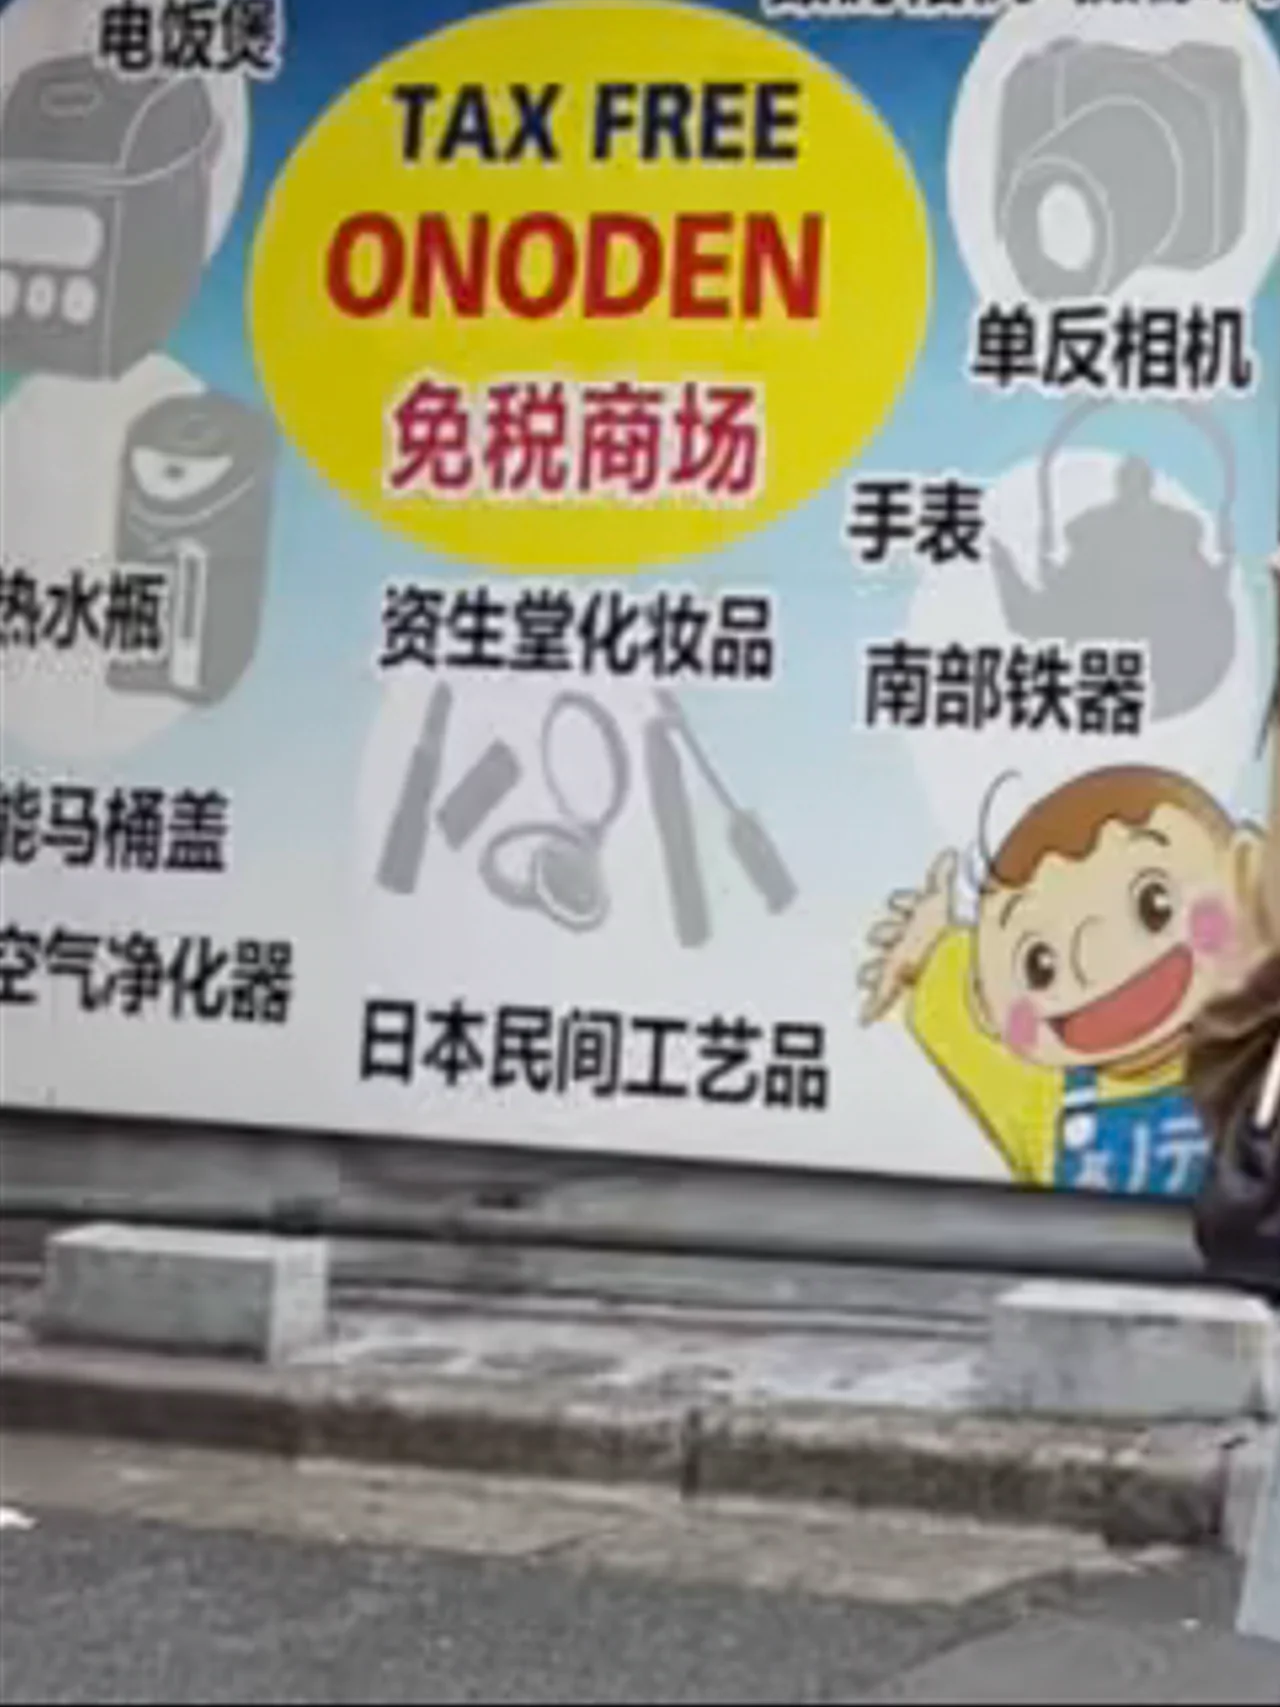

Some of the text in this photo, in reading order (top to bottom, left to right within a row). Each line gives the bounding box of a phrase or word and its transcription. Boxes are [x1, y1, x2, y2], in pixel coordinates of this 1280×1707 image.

[393, 83, 799, 163] TAX FREE
[325, 211, 823, 322] ONODEN
[972, 307, 1253, 391] 单反相机
[389, 381, 758, 497] 免税商场
[847, 483, 984, 563] 手表
[380, 587, 774, 680] 资生堂化妆品
[865, 643, 1145, 735] 南部铁器
[0, 922, 294, 1026] 空气净化器
[361, 999, 828, 1110] 日本民间工艺品
